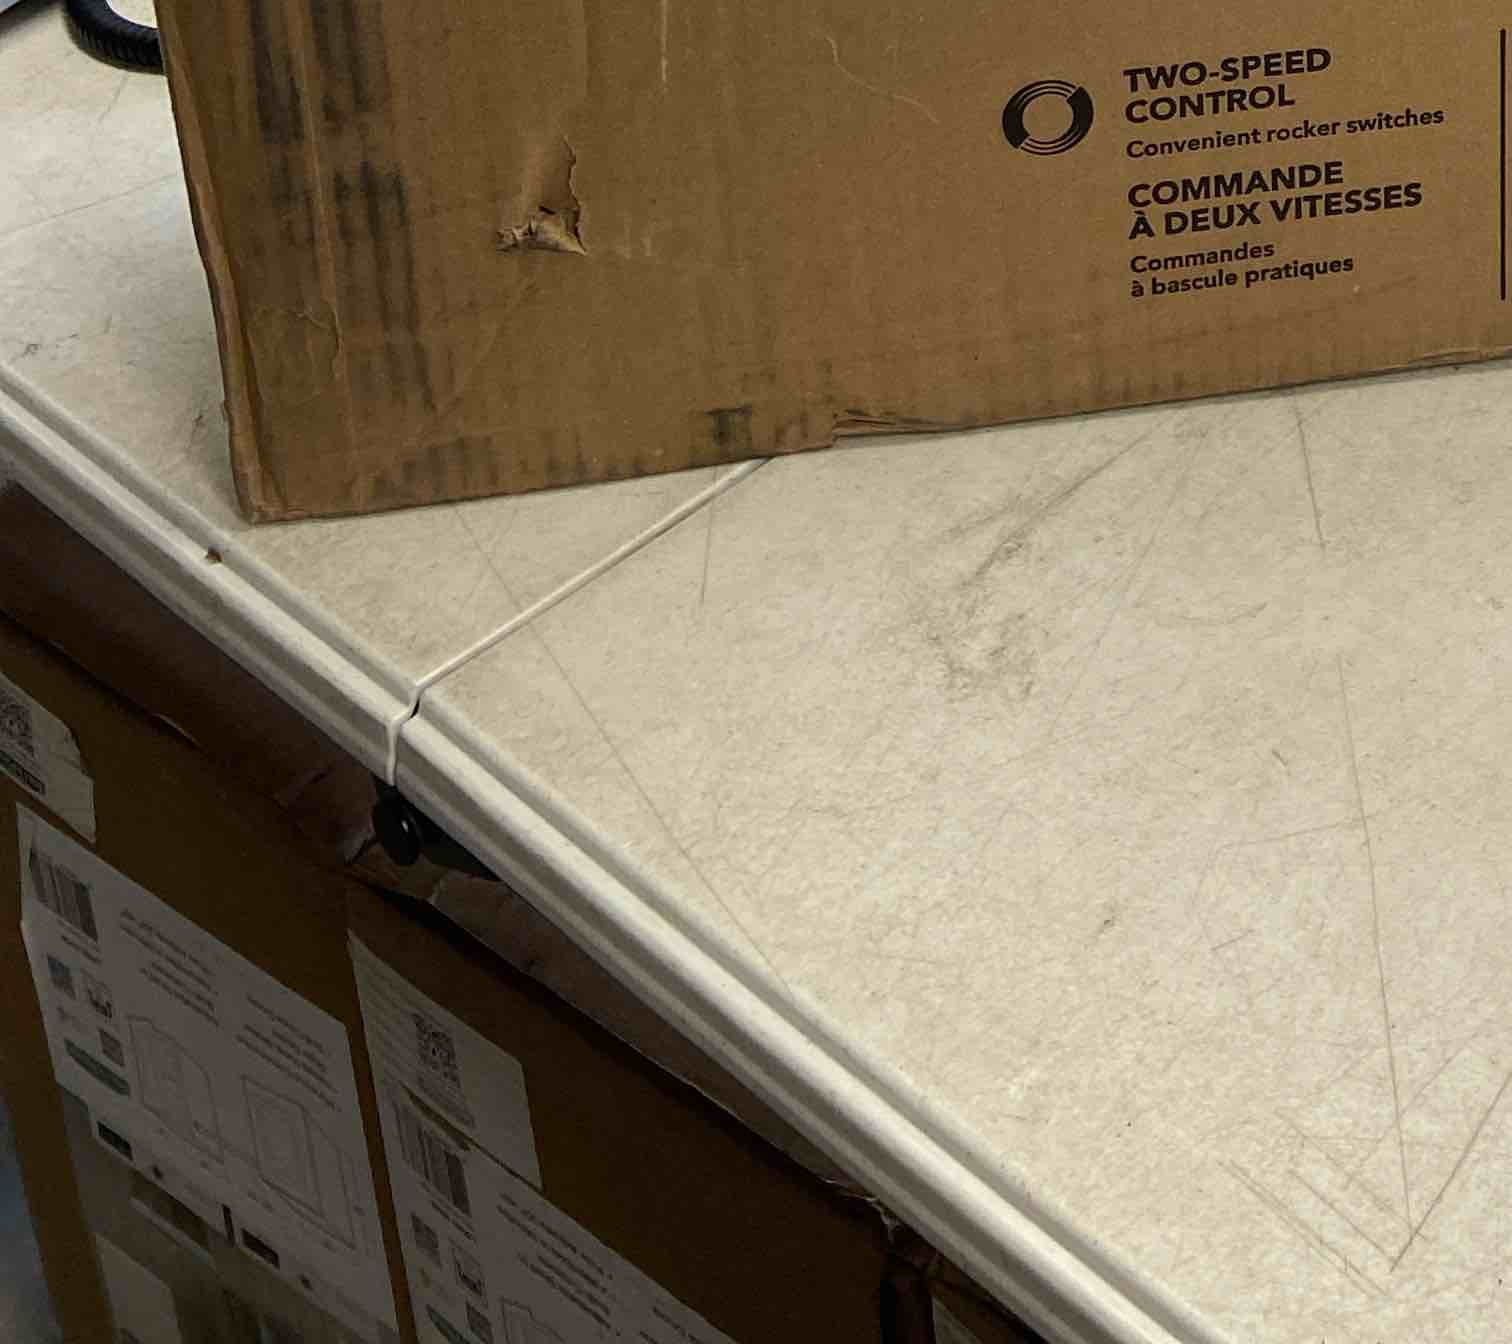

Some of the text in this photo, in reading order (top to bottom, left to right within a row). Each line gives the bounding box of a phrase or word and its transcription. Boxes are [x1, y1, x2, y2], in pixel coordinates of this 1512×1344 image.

[1123, 48, 1331, 92] TWO-SPEED
[1126, 84, 1295, 123] CONTROL
[1127, 108, 1444, 158] Convenient rocker switches
[1128, 161, 1344, 210] COMMANDE
[1129, 183, 1422, 240] À DEUX VITESSES
[1130, 242, 1274, 273] Commandes
[1131, 258, 1353, 297] à bascule pratiques
